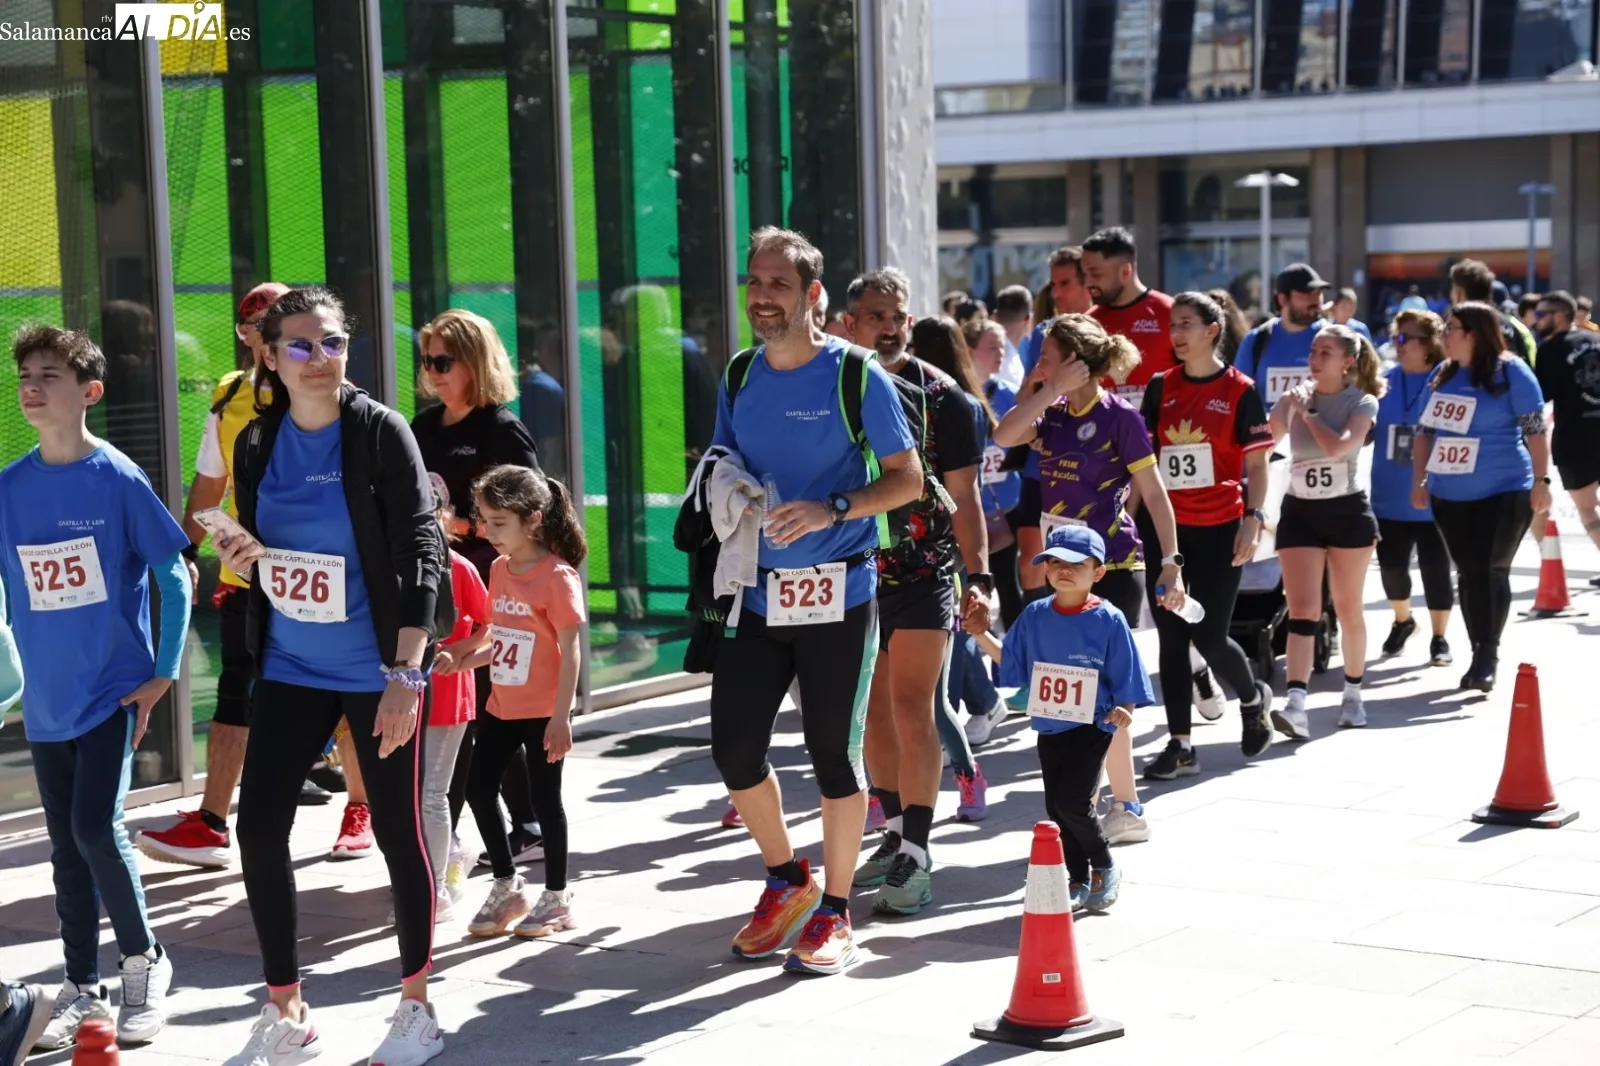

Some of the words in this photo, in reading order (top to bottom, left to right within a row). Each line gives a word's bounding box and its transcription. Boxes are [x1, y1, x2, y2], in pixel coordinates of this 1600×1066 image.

[1270, 375, 1312, 392] 177
[1432, 400, 1467, 422] 599
[983, 454, 1002, 473] 25
[1168, 453, 1197, 478] 93
[1305, 466, 1333, 488] 65
[70, 541, 92, 552] LEÓN
[273, 553, 283, 561] DE
[284, 555, 316, 565] CASTILLA
[322, 560, 343, 568] LEÓN
[30, 555, 87, 593] 525
[791, 568, 817, 577] CASTILL
[271, 565, 329, 604] 526
[779, 577, 833, 609] 523
[491, 637, 519, 670] 24
[1039, 675, 1083, 706] 691
